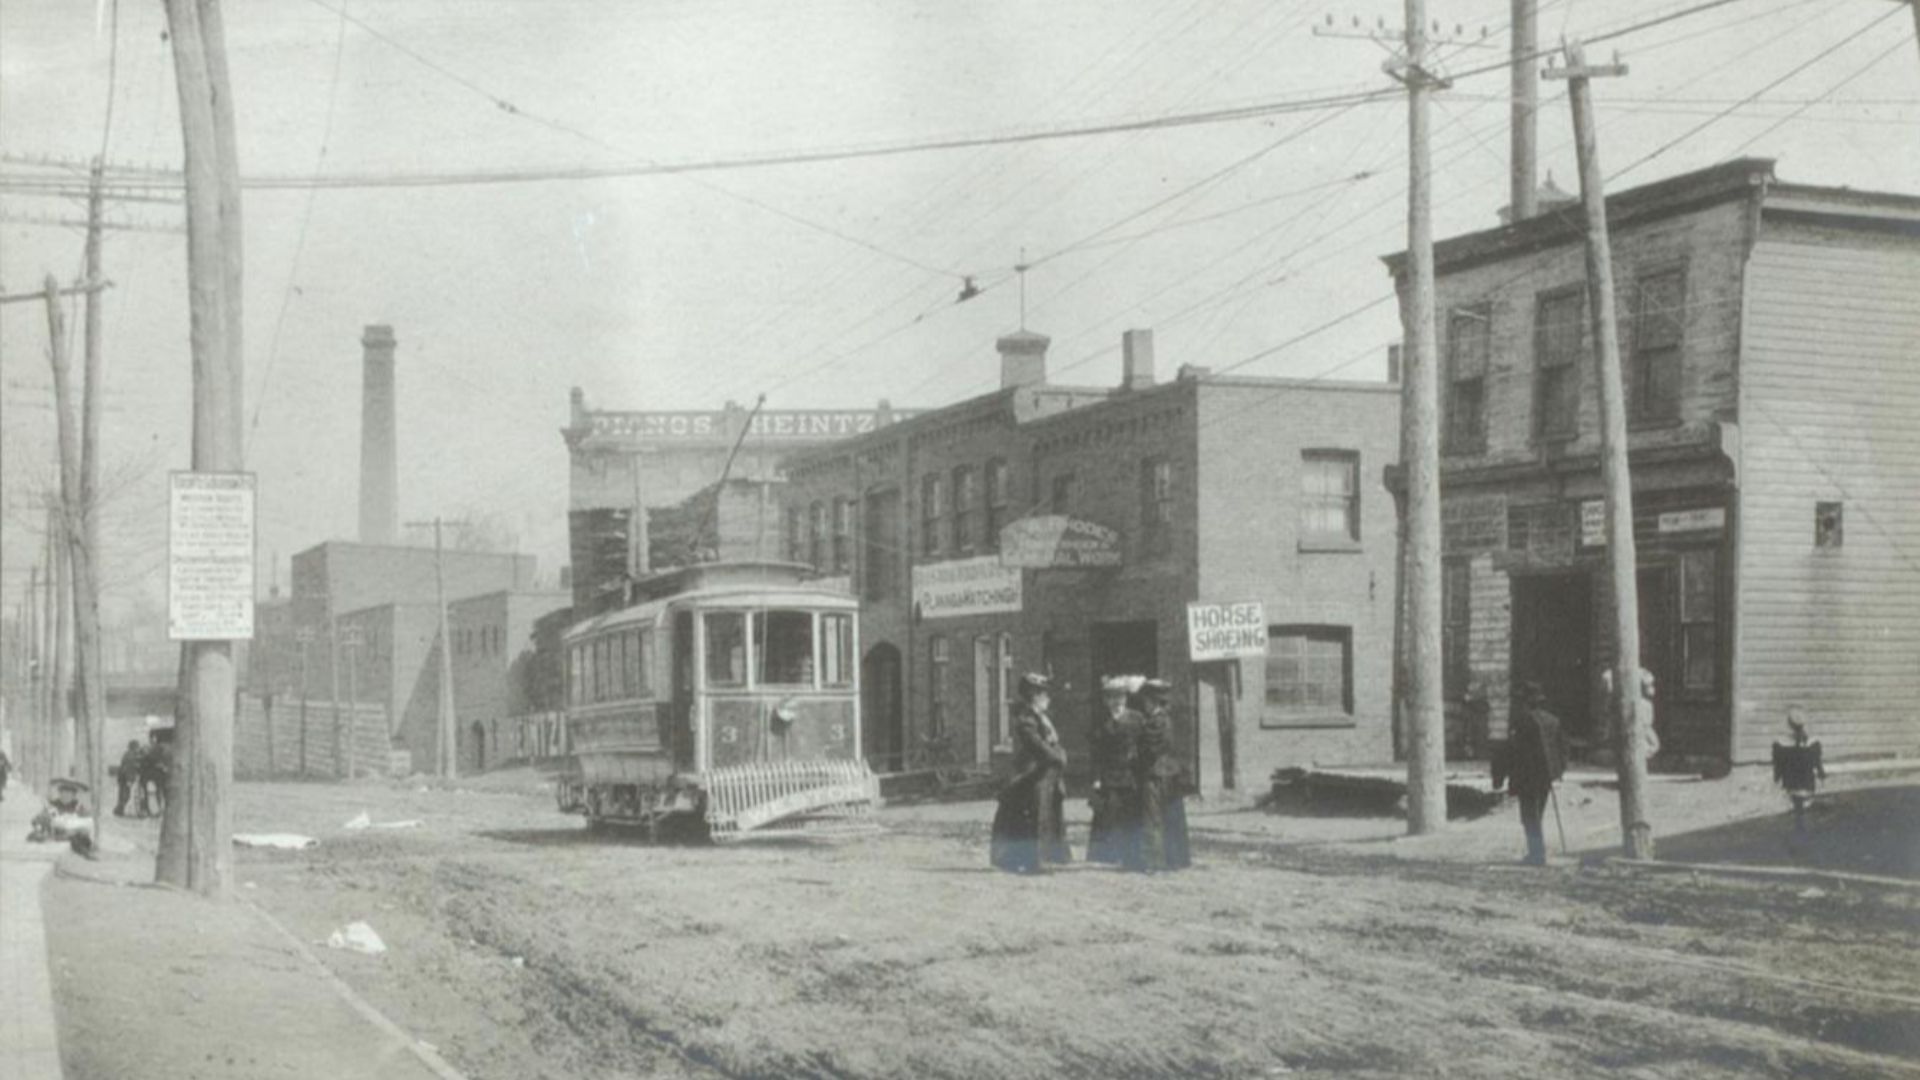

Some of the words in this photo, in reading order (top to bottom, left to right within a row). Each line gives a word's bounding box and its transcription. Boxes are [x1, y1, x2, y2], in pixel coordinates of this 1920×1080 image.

[750, 413, 876, 434] HEINTZ
[1193, 604, 1260, 628] HORSE
[1194, 628, 1266, 652] SHOEING
[721, 726, 738, 743] 3
[829, 724, 845, 741] 3
